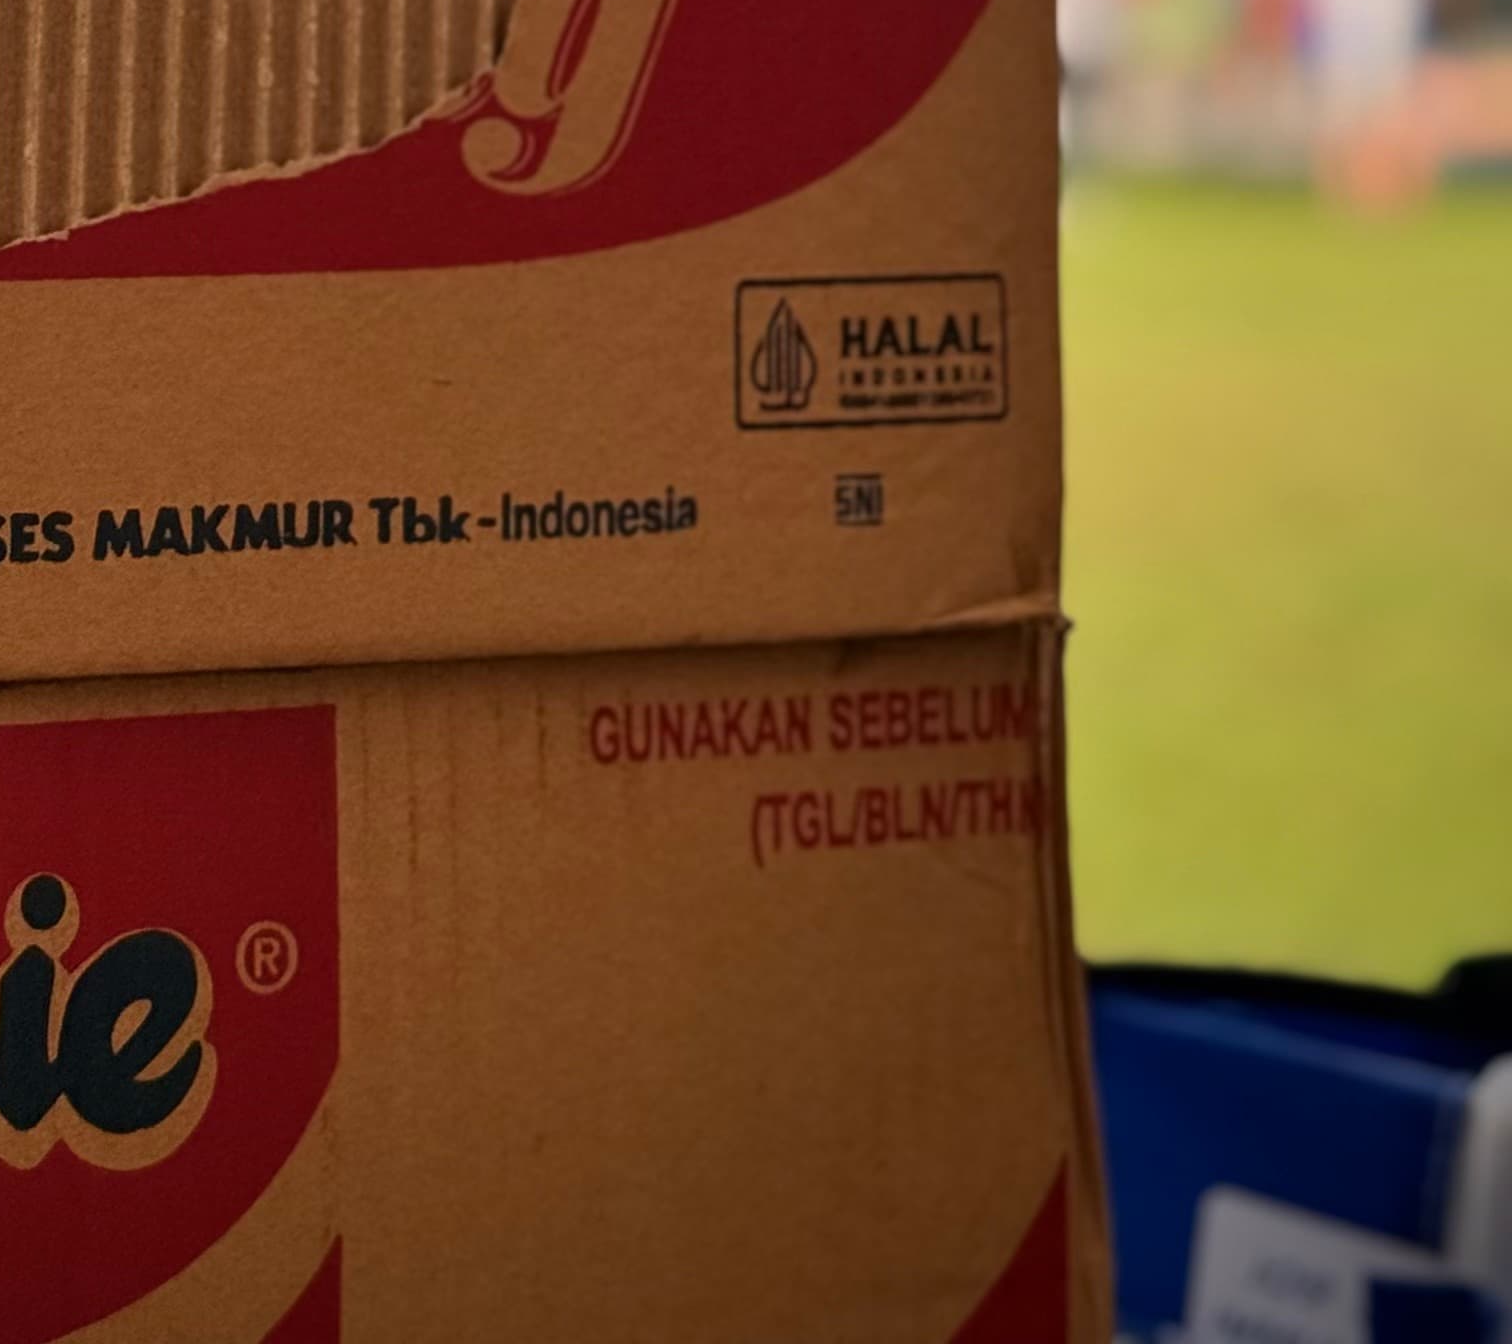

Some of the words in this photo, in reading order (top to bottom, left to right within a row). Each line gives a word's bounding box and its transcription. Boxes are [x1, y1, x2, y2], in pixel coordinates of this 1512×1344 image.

[839, 313, 995, 358] HALAL
[91, 498, 357, 562] MAKMUR
[589, 694, 813, 765] GUNAKAN
